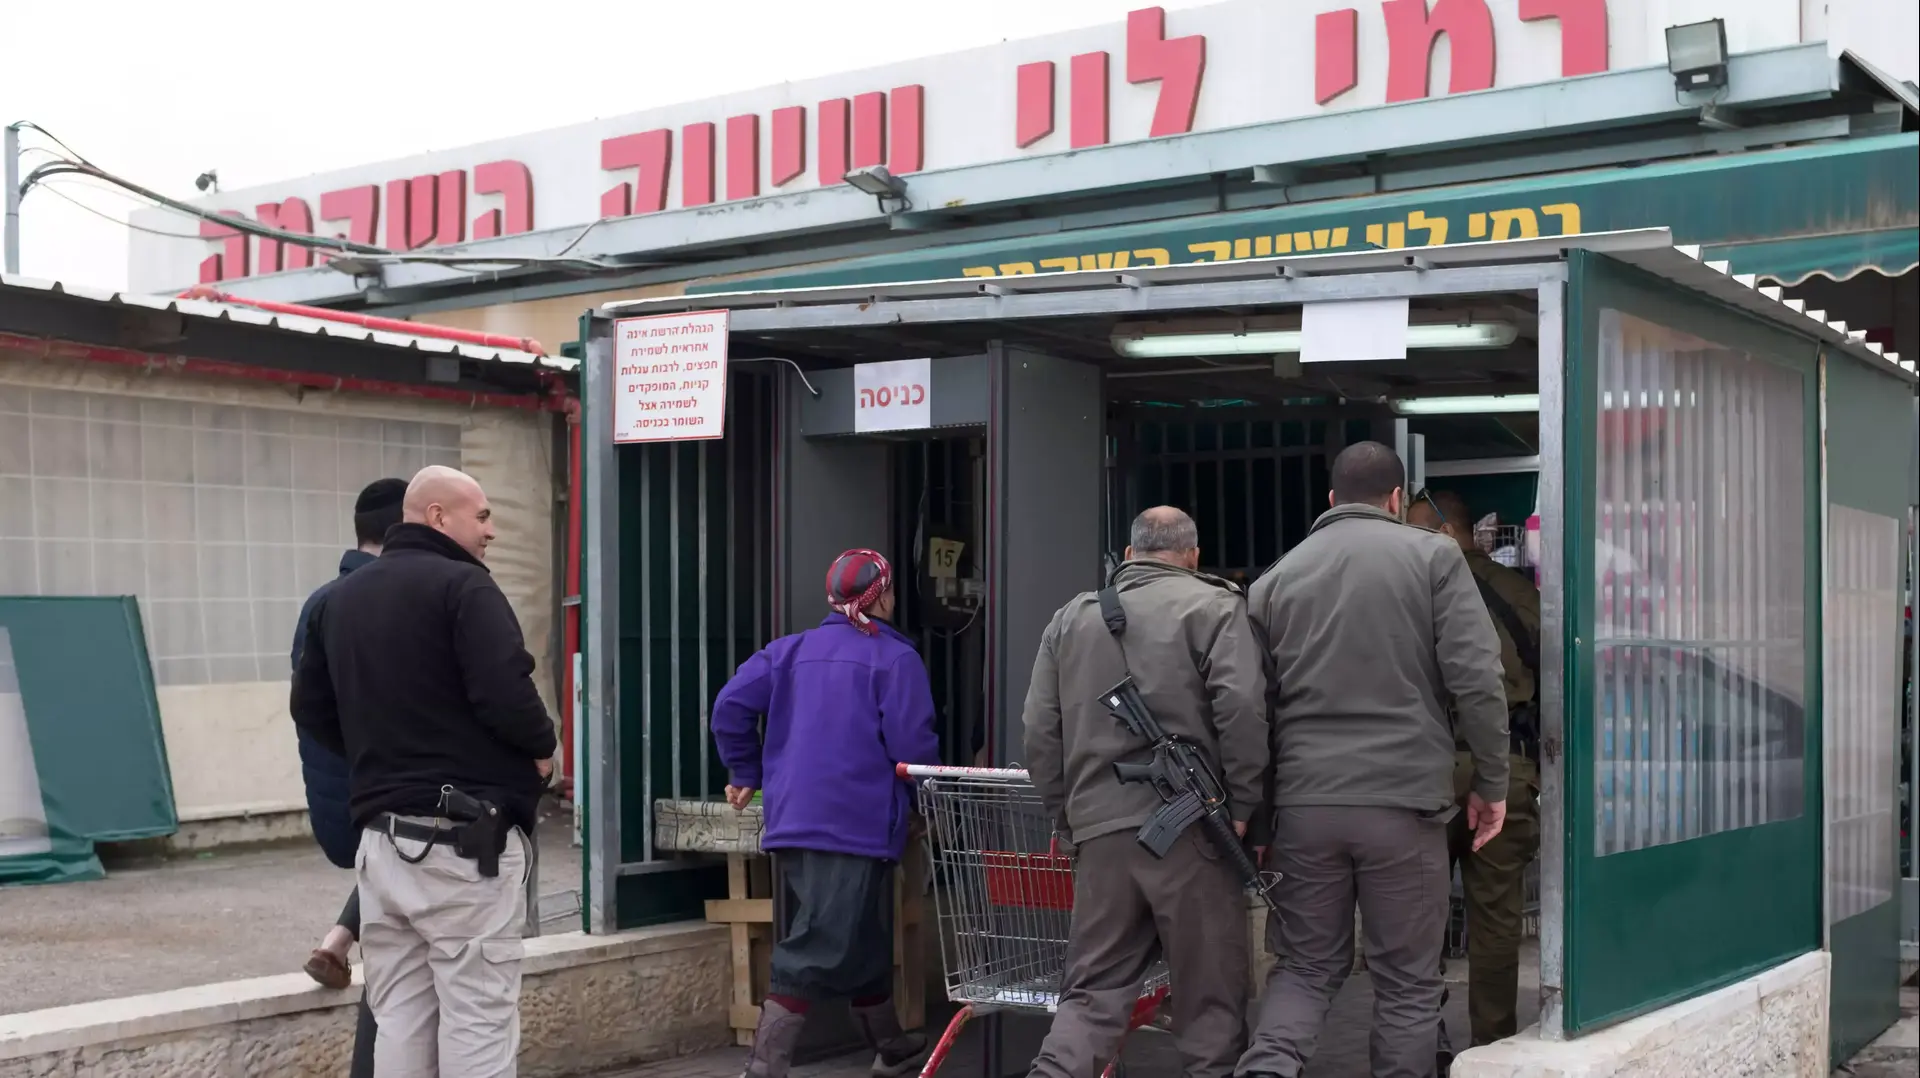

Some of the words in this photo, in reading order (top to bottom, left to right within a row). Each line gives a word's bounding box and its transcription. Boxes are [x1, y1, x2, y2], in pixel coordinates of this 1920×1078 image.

[1315, 0, 1608, 105] רמי
[1016, 6, 1206, 149] לוי
[601, 84, 924, 218] שיווק
[200, 159, 534, 284] השקמה
[1468, 203, 1581, 241] רמי
[1366, 210, 1448, 249] לוי
[626, 330, 647, 339] אינה
[650, 326, 678, 337] הרשת
[681, 323, 714, 334] הנהלת
[631, 343, 668, 357] לשמירת
[671, 342, 708, 354] אחראית
[621, 364, 649, 376] עגלות
[652, 360, 679, 373] לרבות
[628, 381, 676, 394] המופקדים
[660, 396, 697, 409] לשמירה
[861, 384, 925, 408] כניסה
[639, 399, 657, 411] אצל
[633, 417, 669, 428] בכניסה.
[672, 416, 704, 426] השומר
[935, 547, 955, 567] 15
